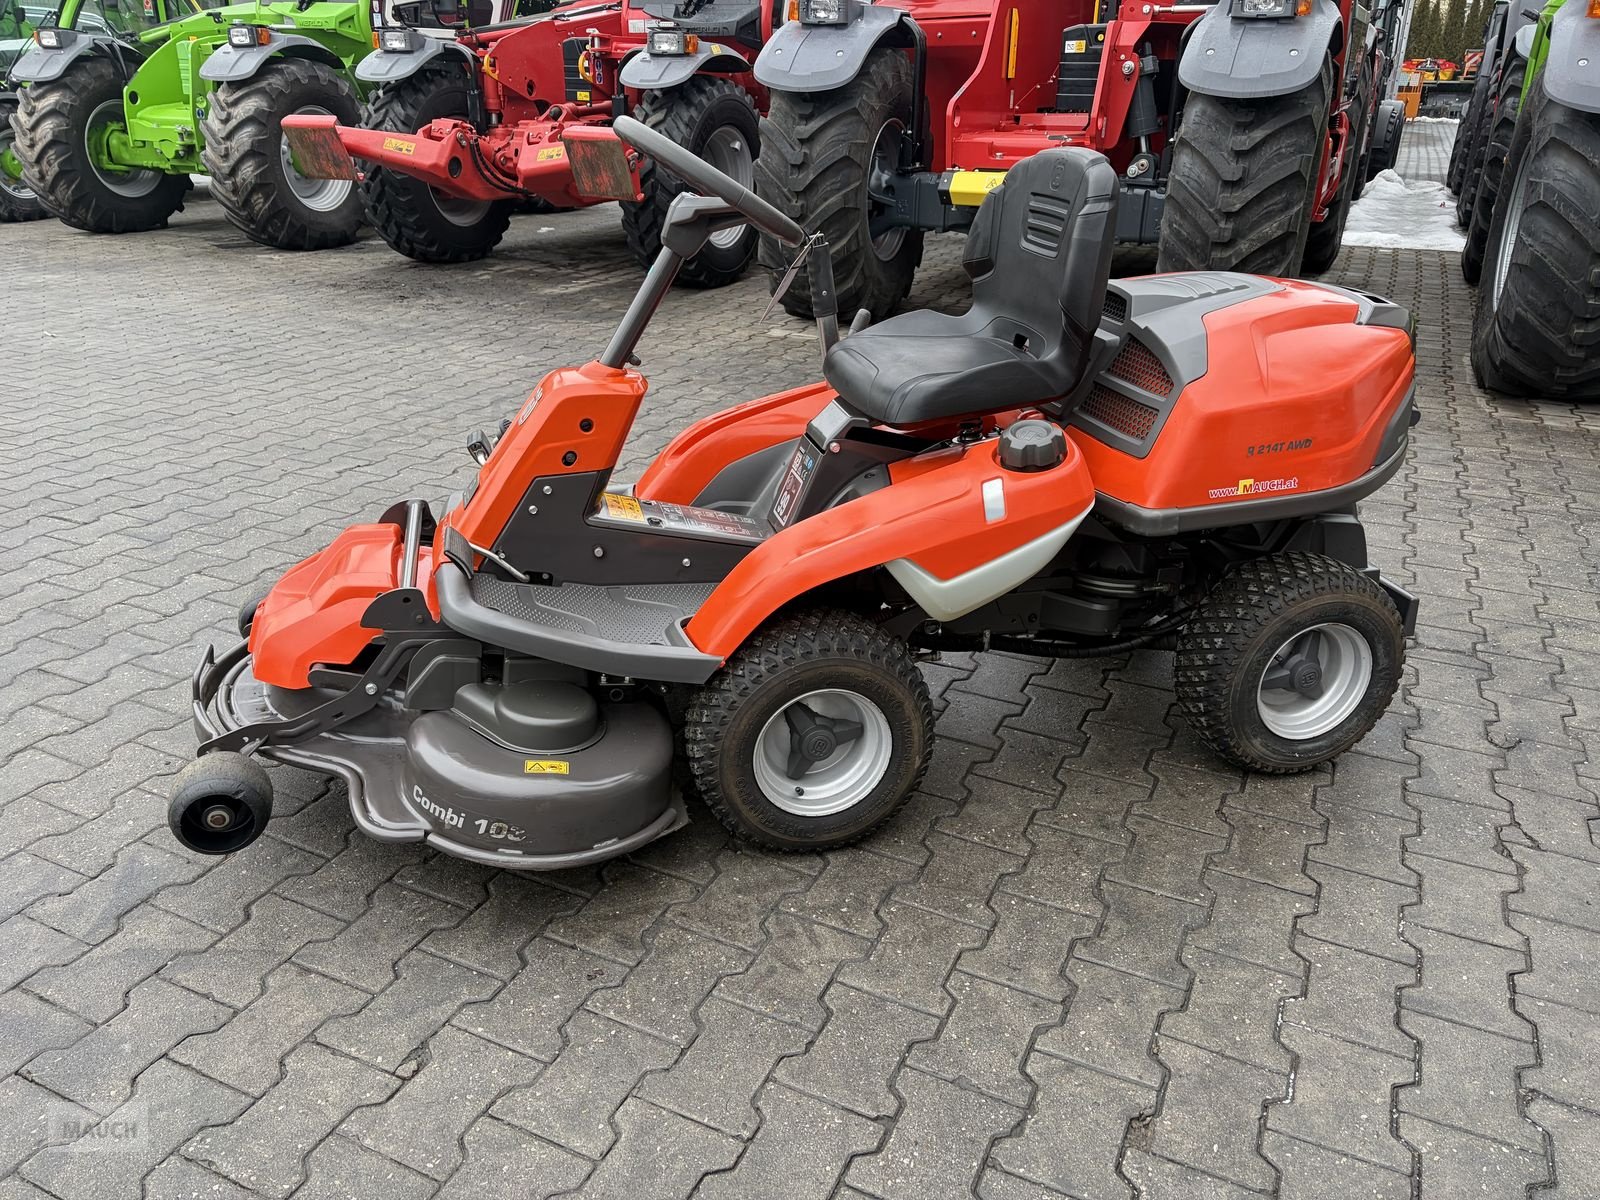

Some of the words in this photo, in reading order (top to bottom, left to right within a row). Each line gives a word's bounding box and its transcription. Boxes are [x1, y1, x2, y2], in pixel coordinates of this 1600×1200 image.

[1257, 442, 1285, 455] 214T
[1287, 438, 1313, 451] AWD
[413, 784, 466, 828] Combi
